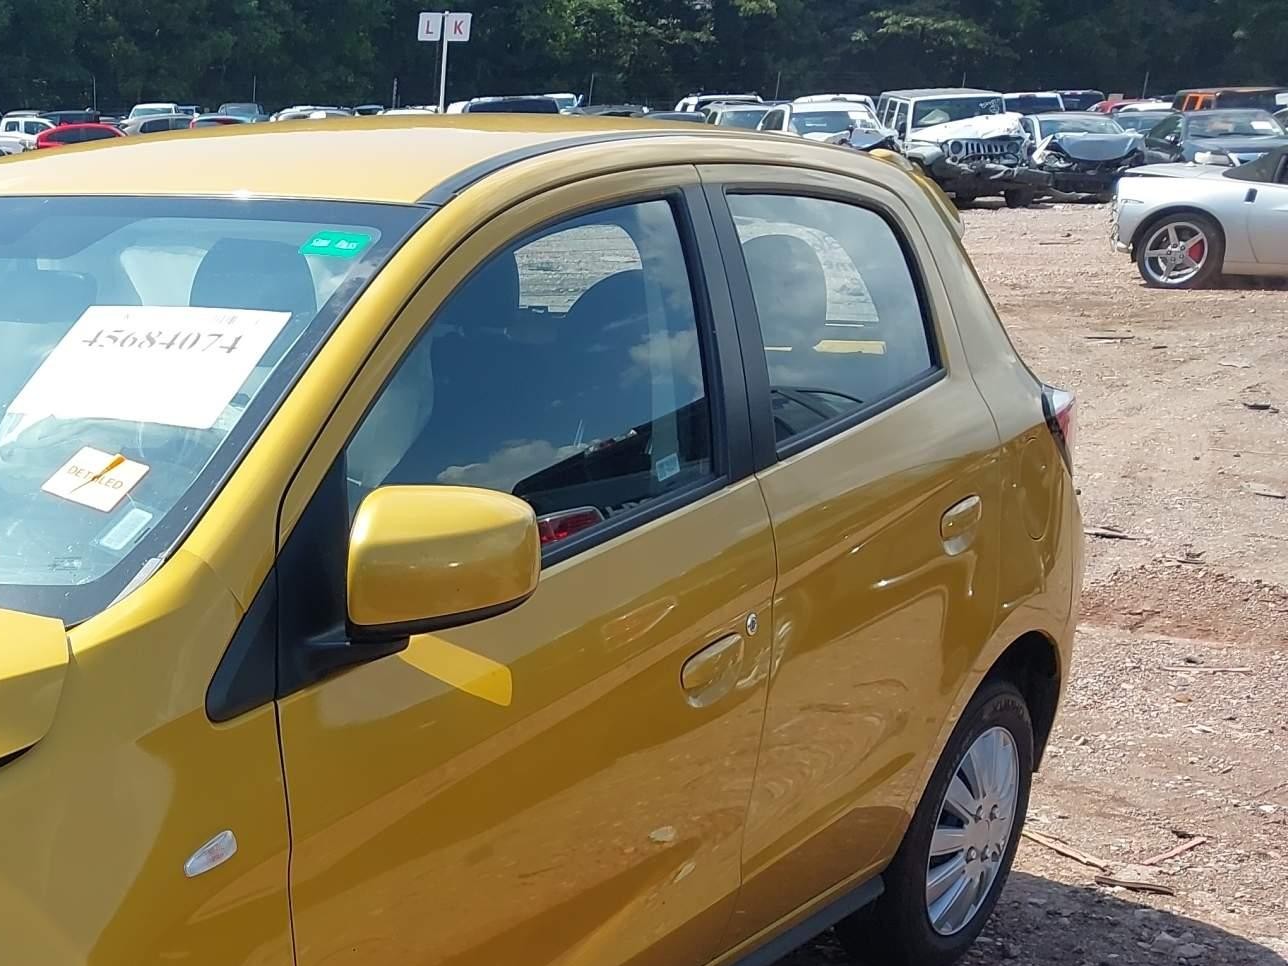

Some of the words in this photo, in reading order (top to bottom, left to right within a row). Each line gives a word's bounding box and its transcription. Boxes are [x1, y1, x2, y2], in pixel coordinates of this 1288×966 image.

[425, 20, 434, 35] L
[454, 20, 464, 35] K
[82, 329, 243, 354] 45684074
[67, 464, 124, 490] DETLED
